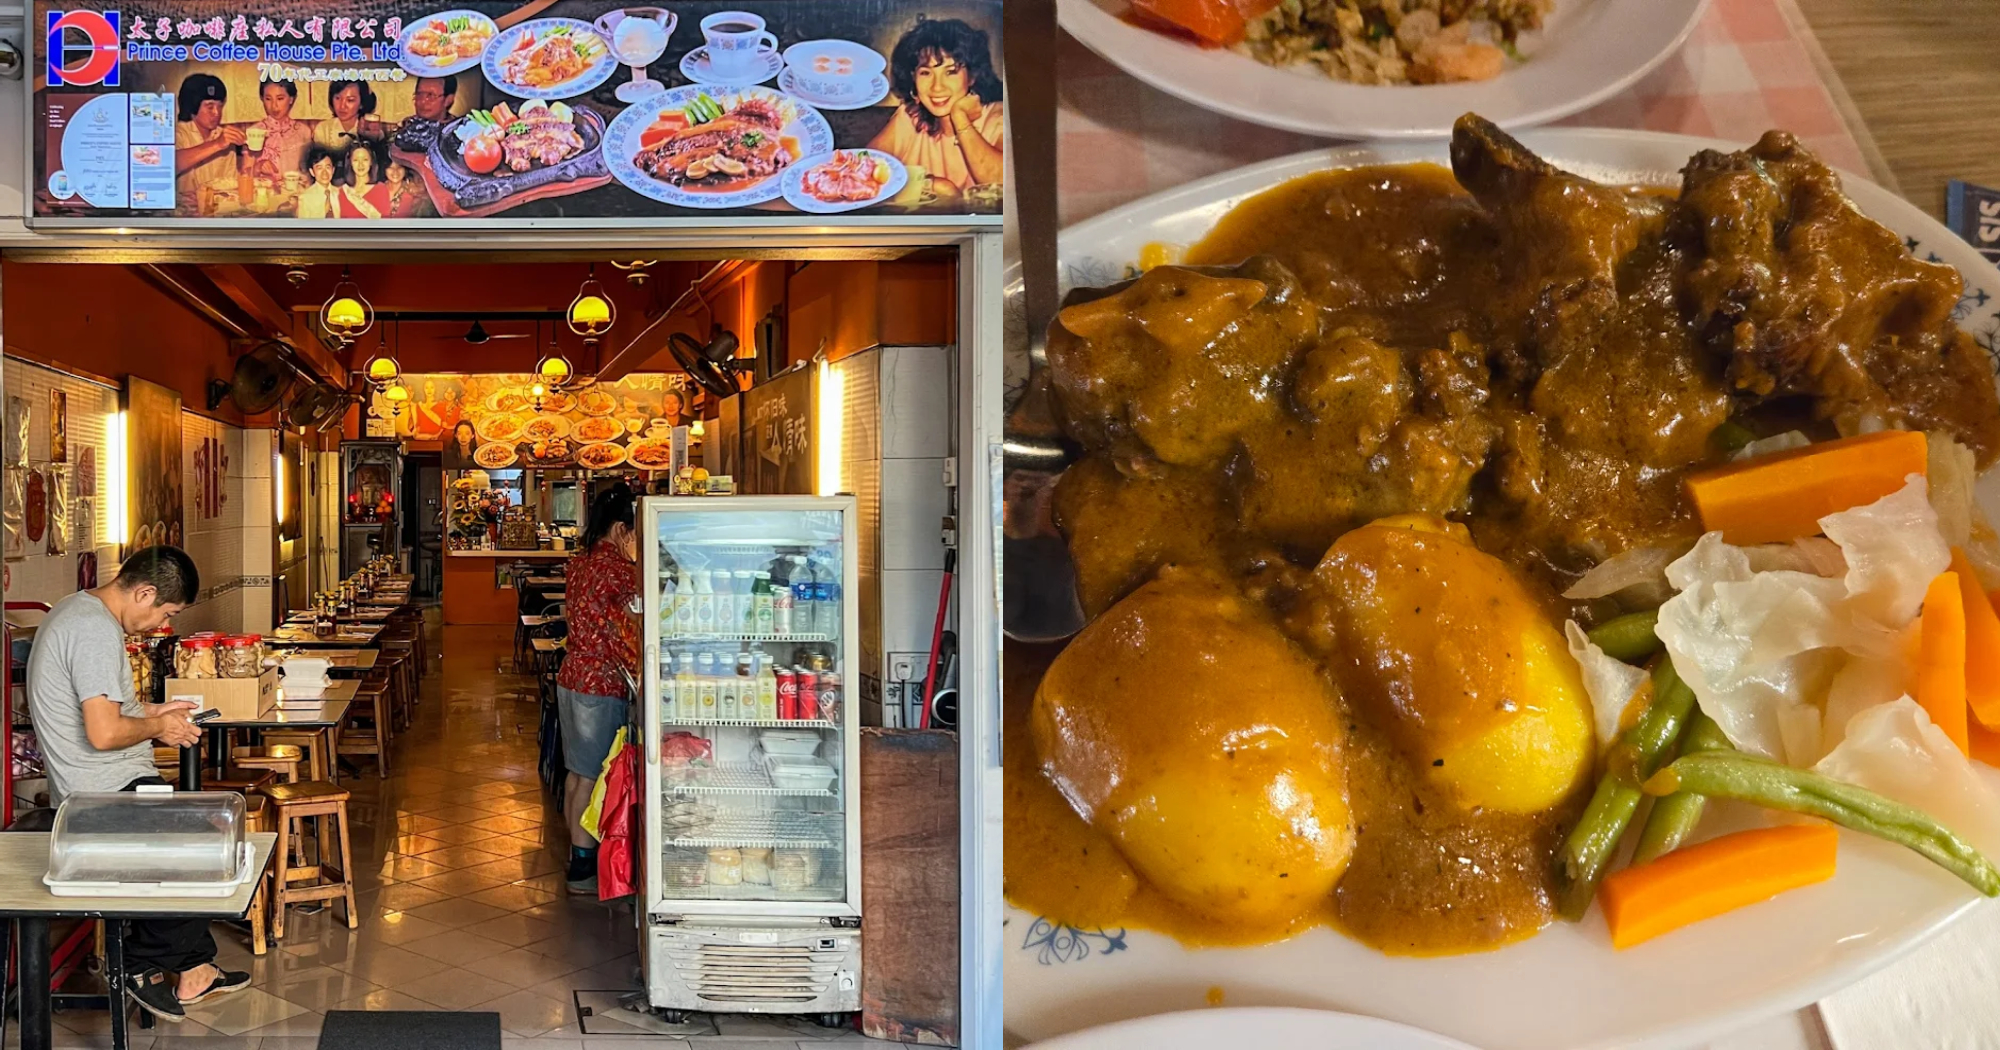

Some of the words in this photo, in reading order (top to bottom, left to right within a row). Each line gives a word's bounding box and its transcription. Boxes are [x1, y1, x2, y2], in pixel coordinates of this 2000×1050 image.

[127, 14, 402, 42] 太子咖啡座私人有限公司
[127, 41, 188, 61] Prince
[192, 41, 260, 61] Coffee
[264, 41, 326, 61] House
[330, 41, 367, 61] Pte.
[372, 41, 406, 61] Ltd.
